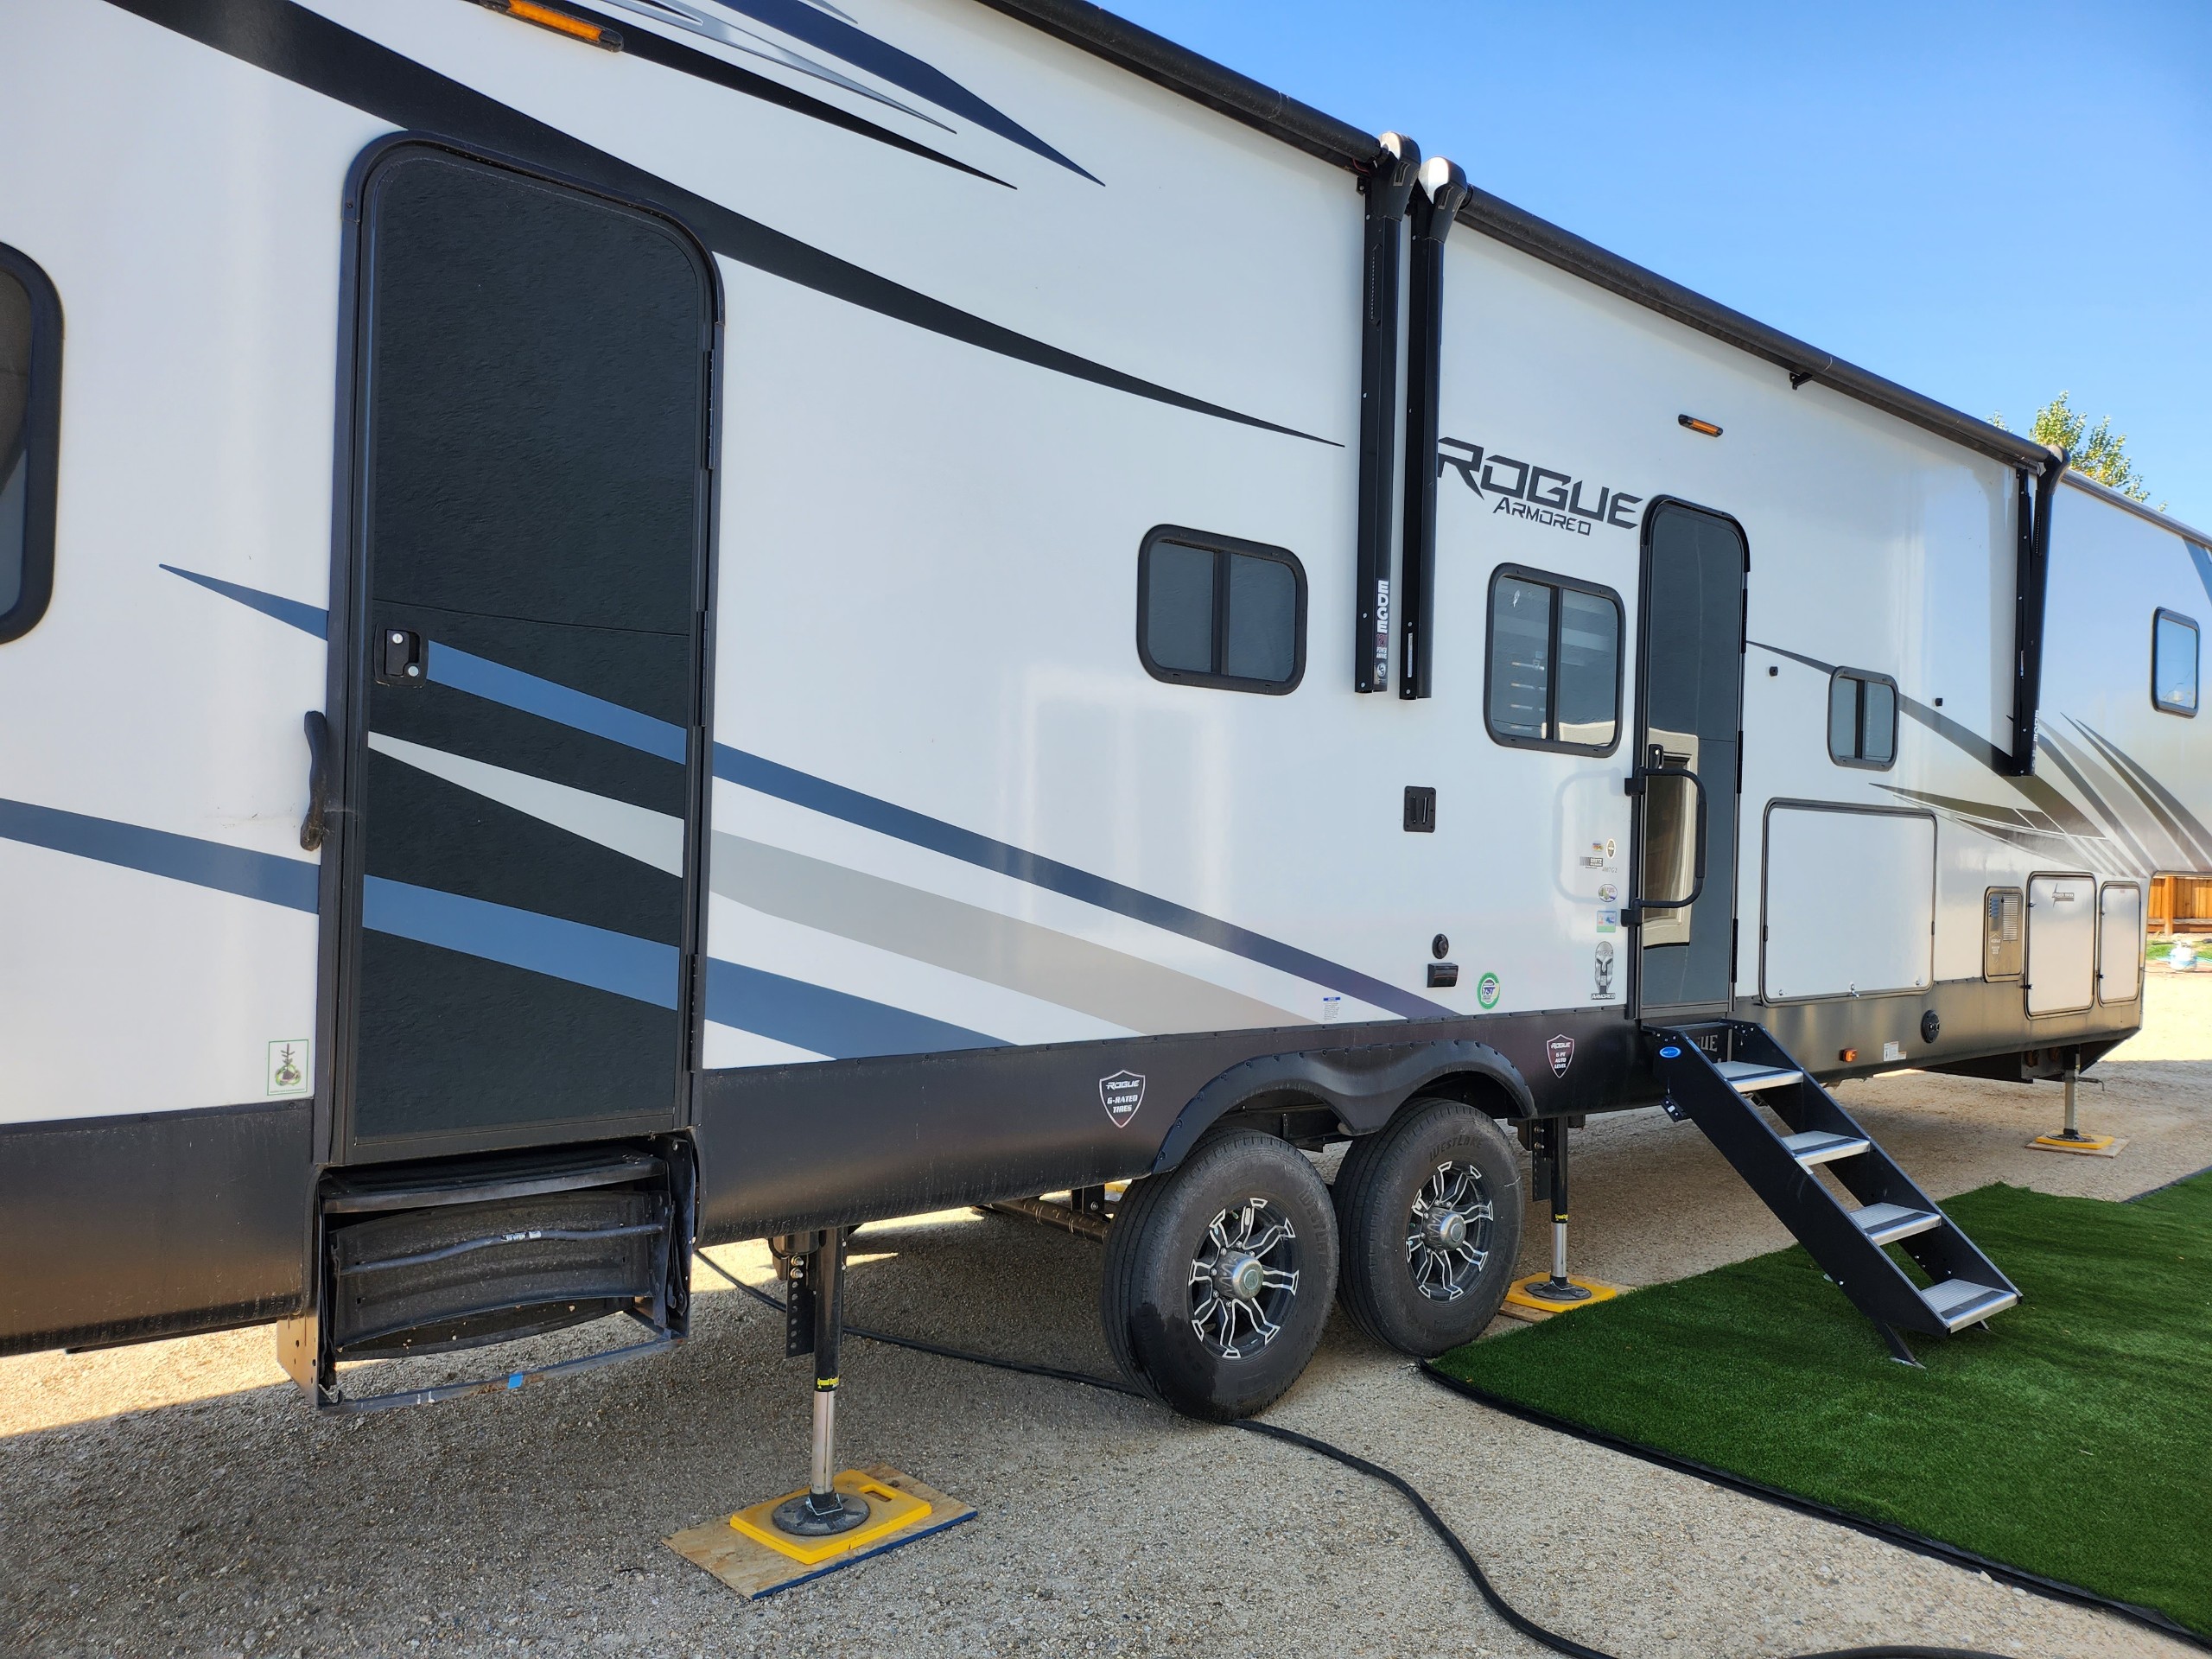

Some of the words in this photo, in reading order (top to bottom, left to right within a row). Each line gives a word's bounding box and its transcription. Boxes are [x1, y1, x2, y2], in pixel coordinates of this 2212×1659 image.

[1437, 436, 1643, 530] ROGUE
[1492, 496, 1592, 537] ARMORED
[1376, 580, 1389, 634] EDGE
[1106, 1079, 1141, 1090] ROGUE
[1107, 1094, 1139, 1105] G-RATED
[1112, 1104, 1133, 1114] TIRES
[1429, 1134, 1484, 1163] WESTLAKE
